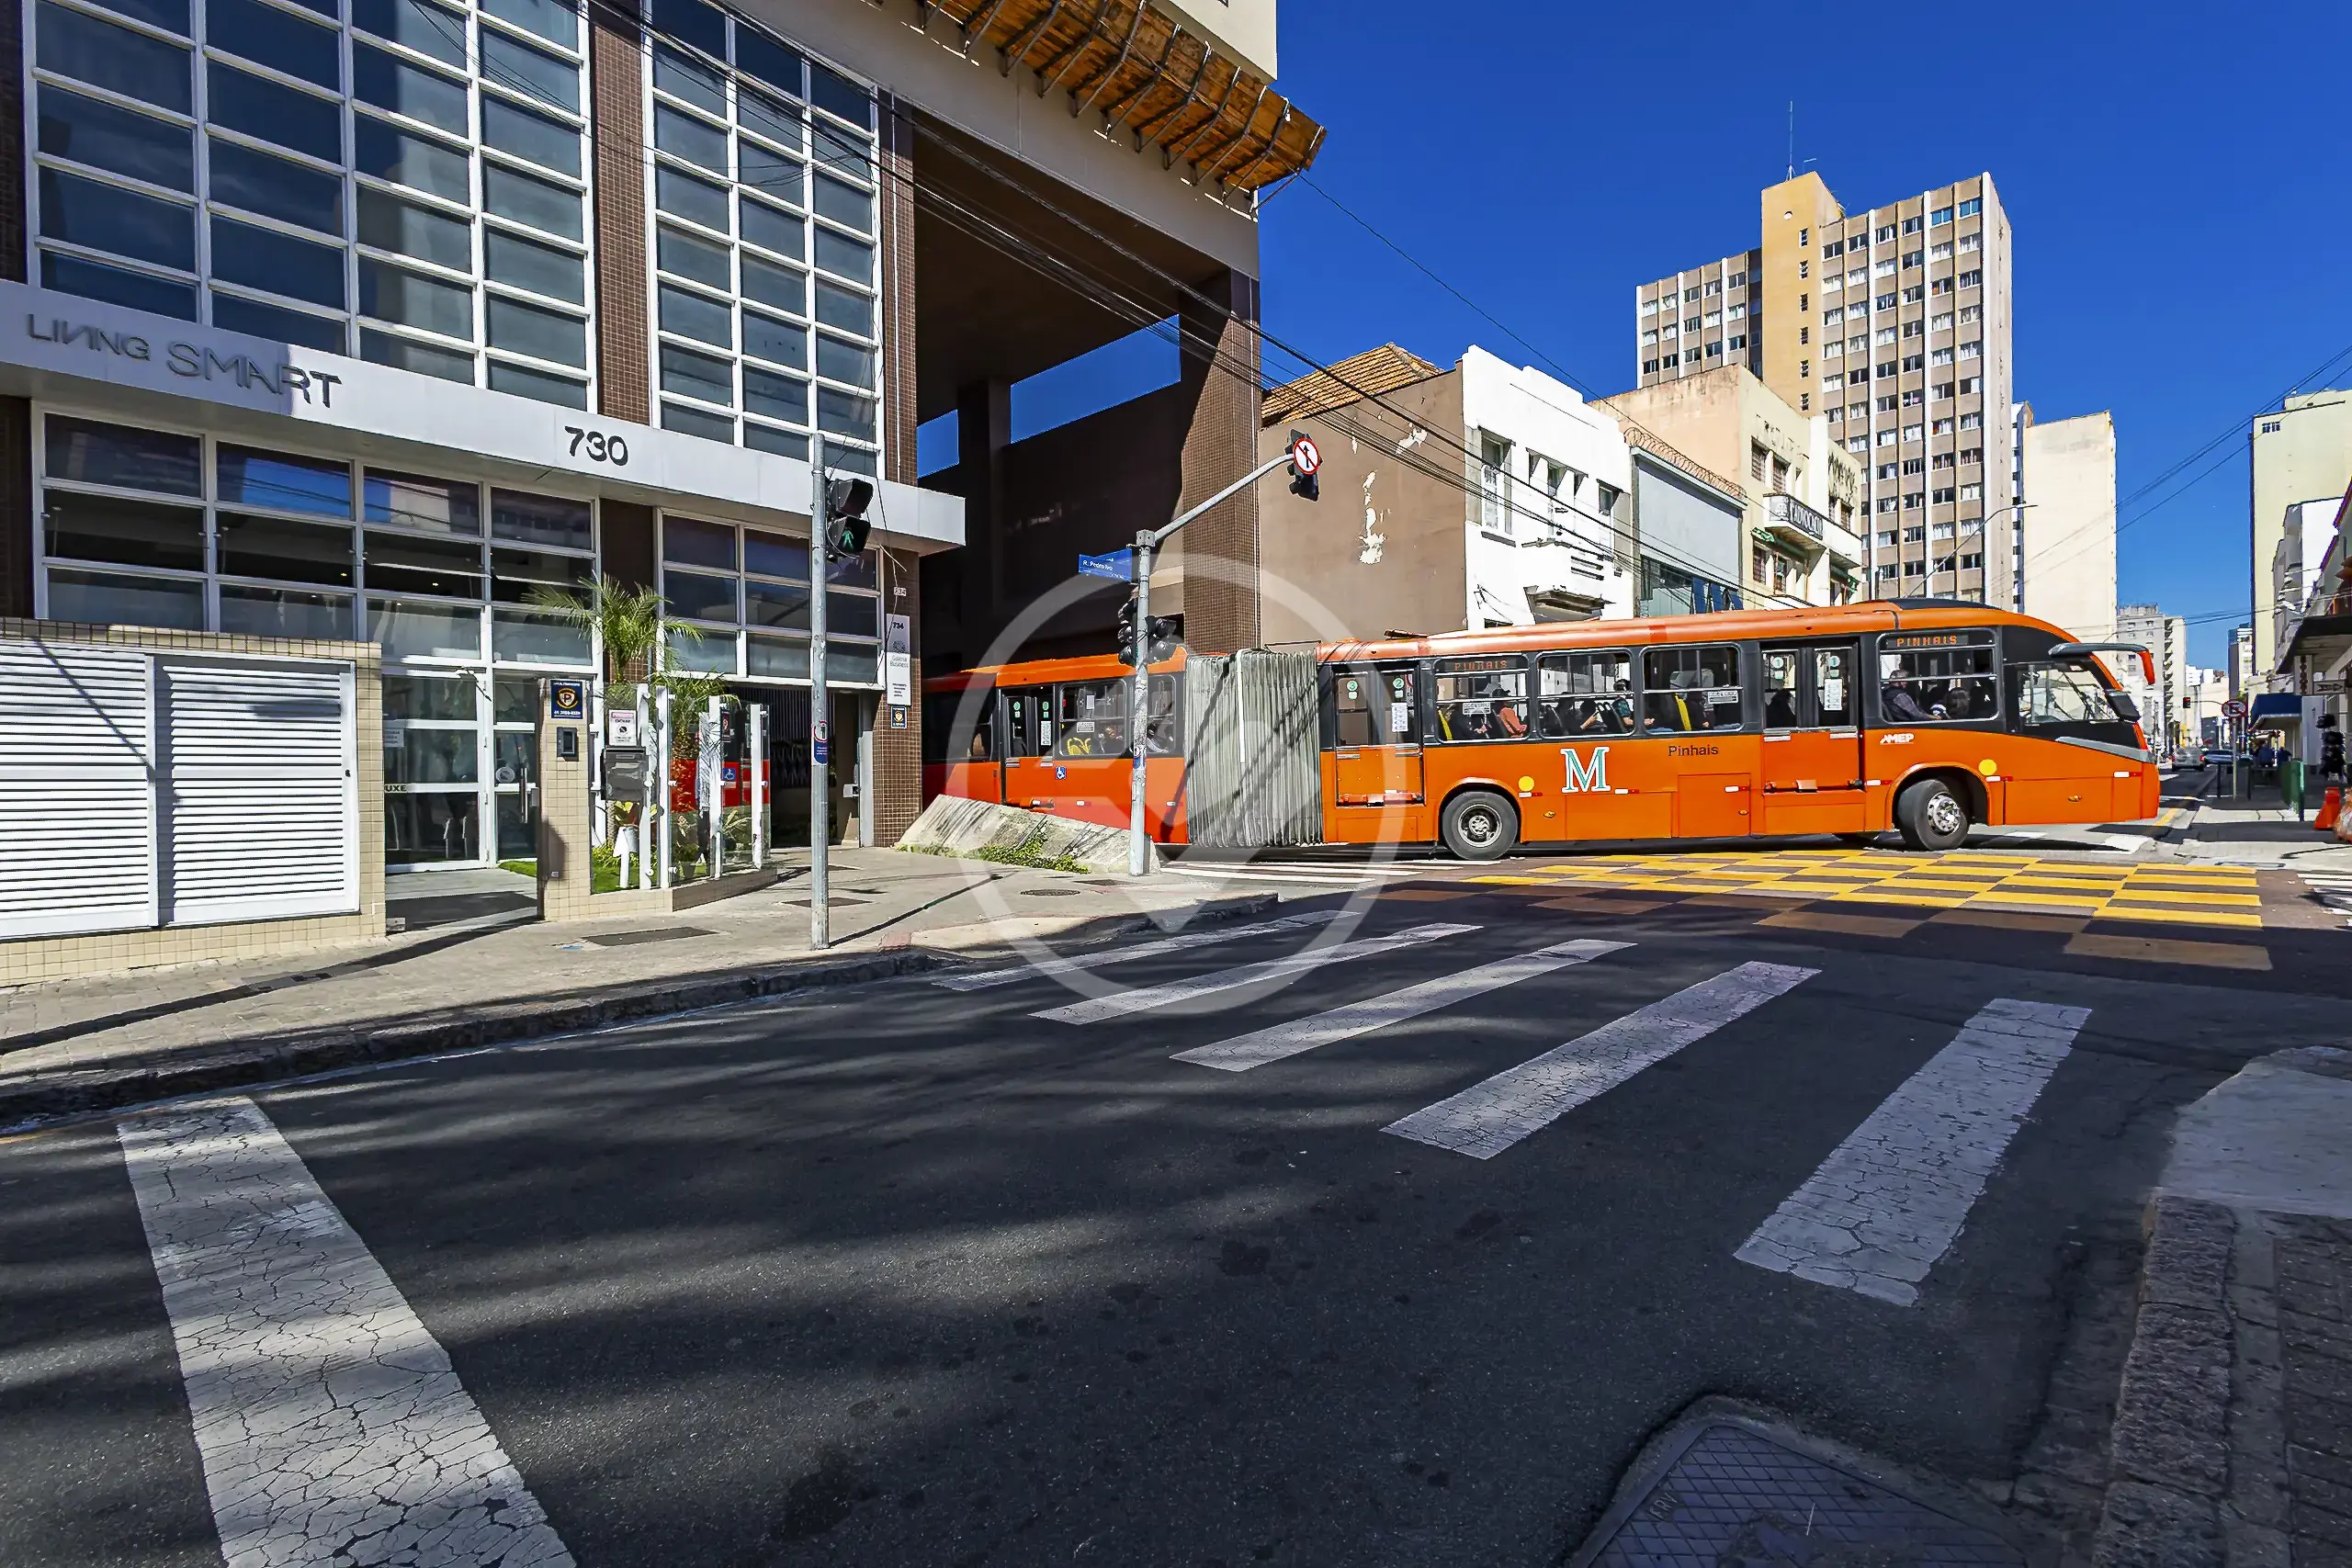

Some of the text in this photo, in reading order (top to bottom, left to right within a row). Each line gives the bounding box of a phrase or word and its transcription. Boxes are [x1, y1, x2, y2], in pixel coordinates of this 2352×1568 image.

[166, 341, 342, 409] SMART
[564, 425, 628, 467] 730
[1349, 681, 1355, 691] 3
[1396, 679, 1402, 688] 2
[1668, 744, 1719, 757] Pinhais
[1560, 746, 1611, 793] M
[384, 784, 407, 793] UXE
